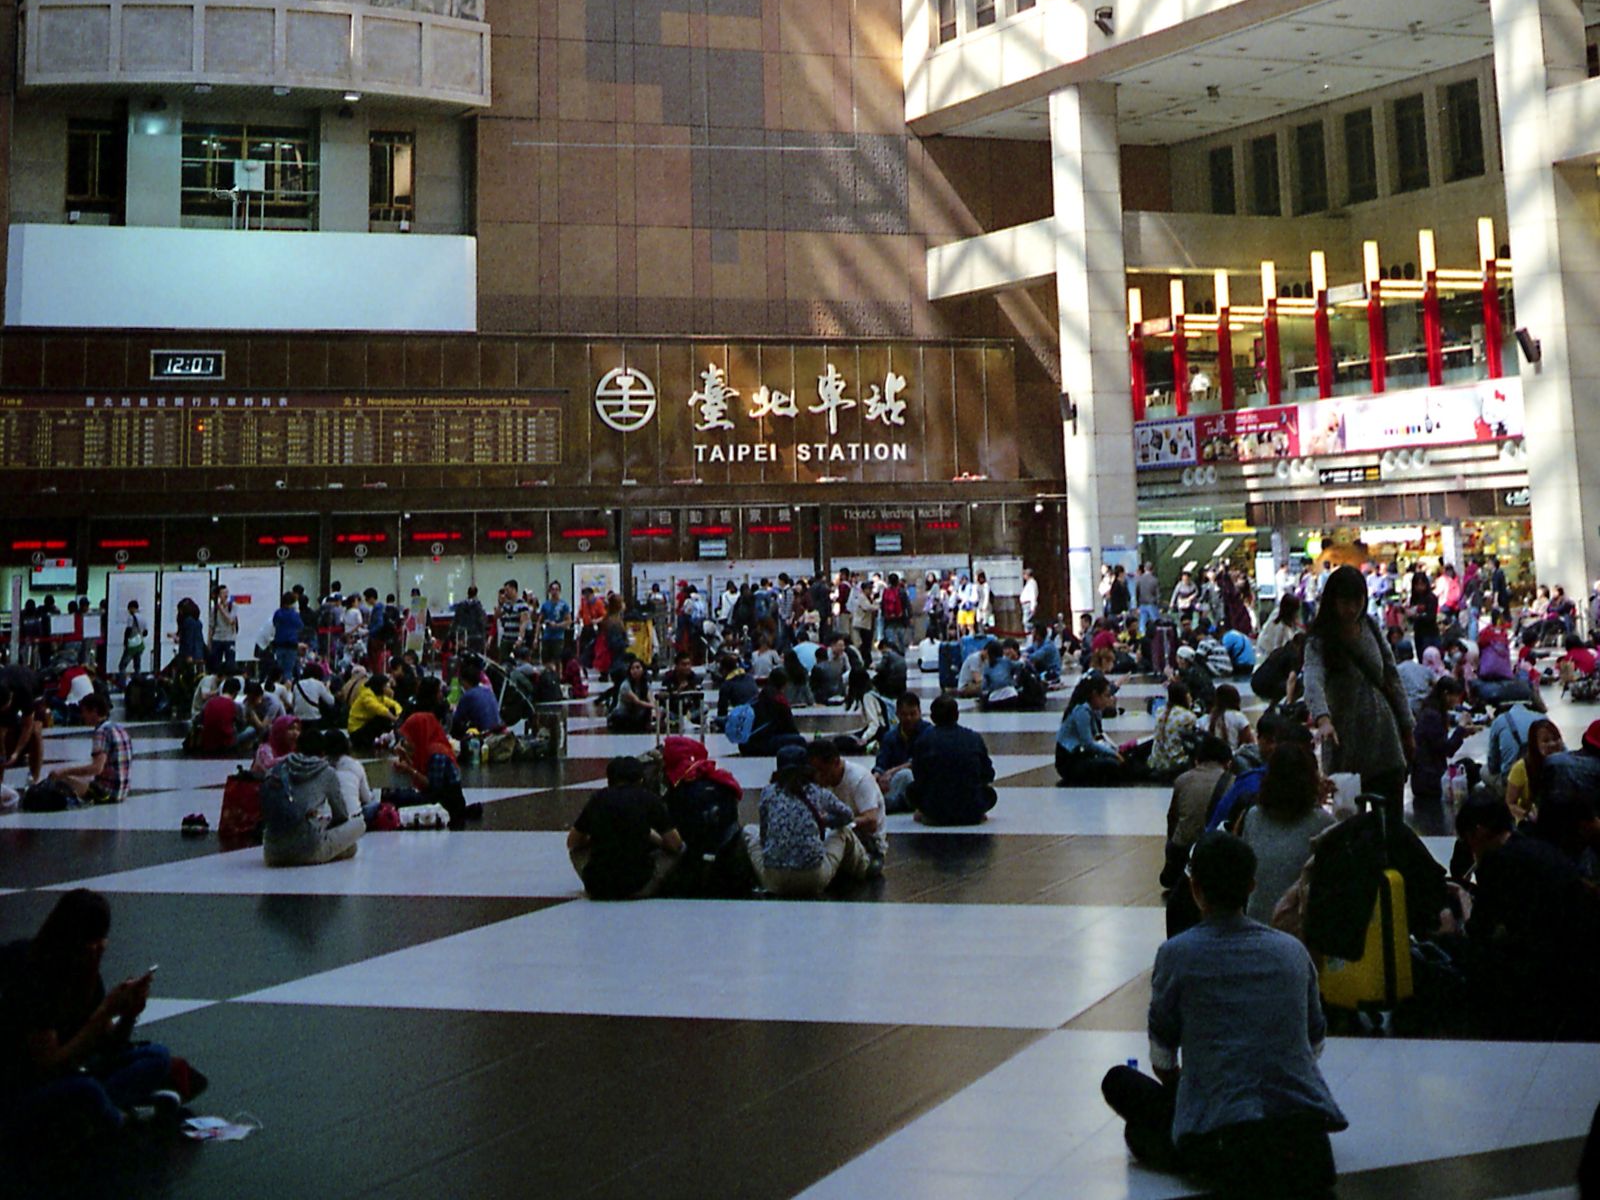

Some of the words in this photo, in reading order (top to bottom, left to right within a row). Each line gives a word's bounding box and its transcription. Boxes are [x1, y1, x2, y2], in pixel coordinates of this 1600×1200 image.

[166, 357, 215, 373] 12:07
[367, 397, 416, 406] Northbound
[423, 397, 466, 406] Eastbound
[468, 396, 508, 408] Departure
[510, 396, 530, 406] Time
[688, 362, 907, 435] 臺北車站
[694, 445, 777, 462] TAIPEI
[797, 443, 907, 461] STATION
